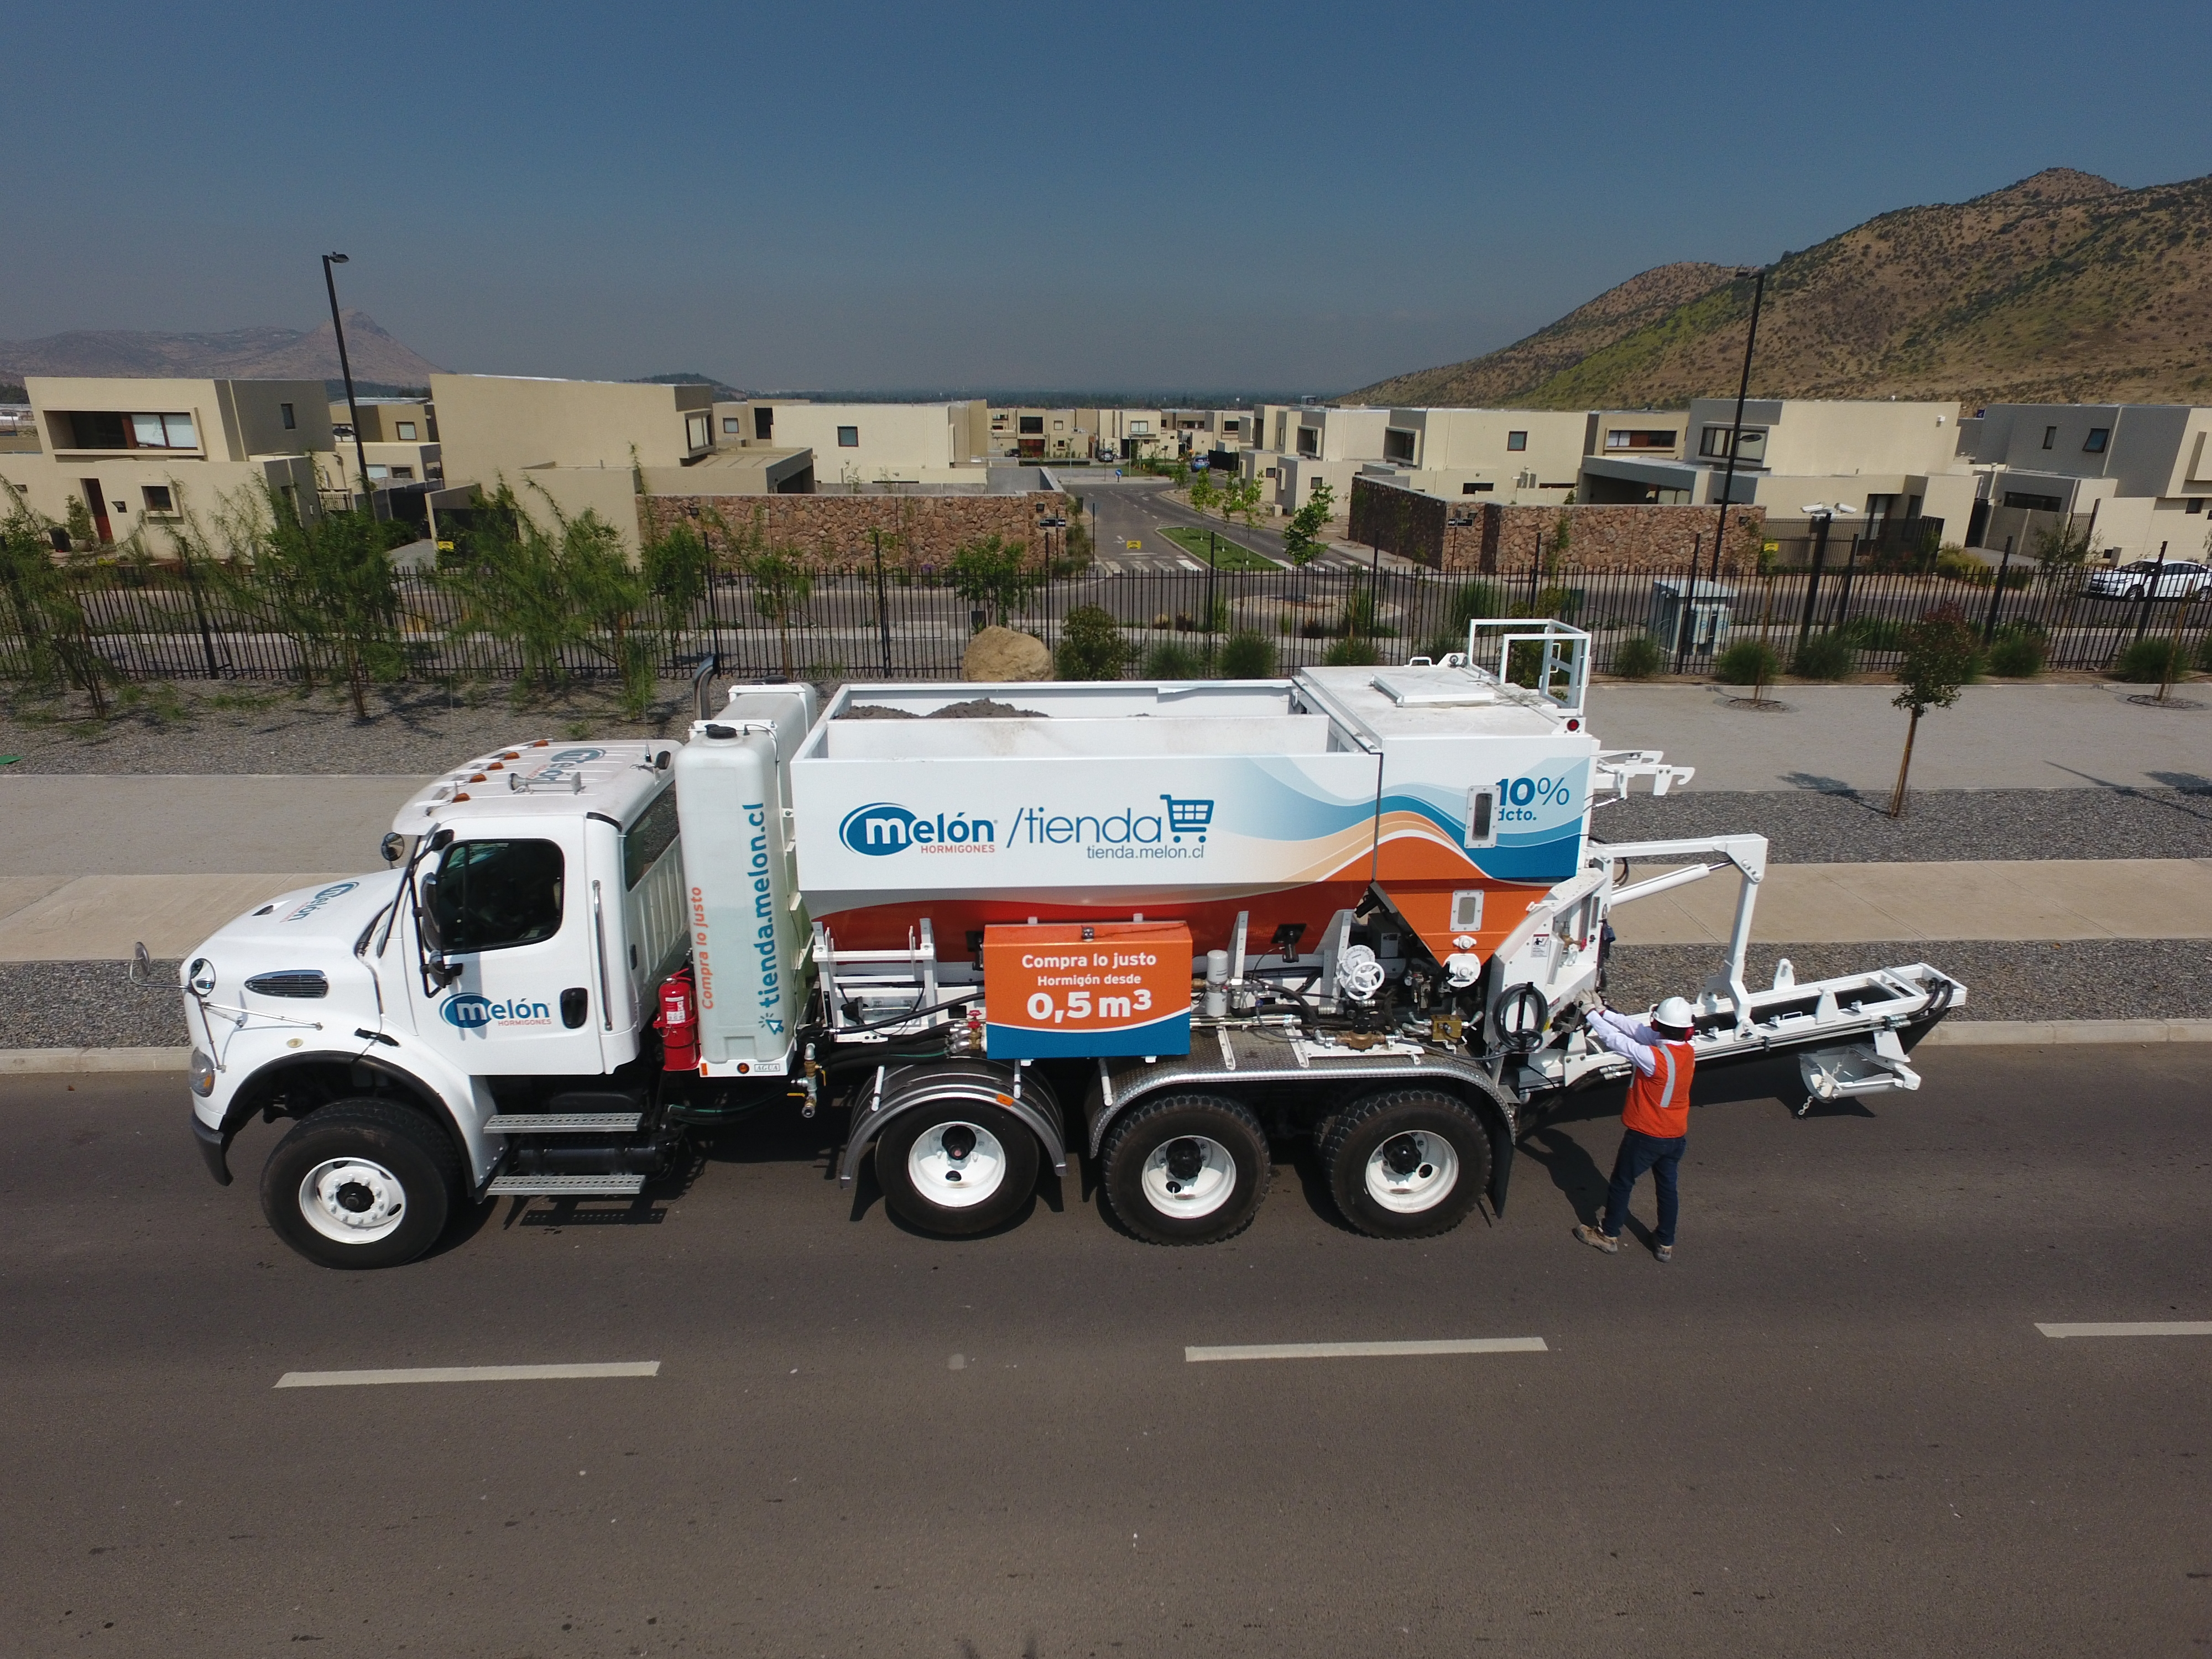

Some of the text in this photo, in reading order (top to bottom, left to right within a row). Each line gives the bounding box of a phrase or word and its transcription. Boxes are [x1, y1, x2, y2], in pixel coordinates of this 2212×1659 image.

[1495, 777, 1570, 806] 10%
[865, 812, 994, 845] melón
[921, 844, 995, 854] HORMIGONES
[1087, 845, 1204, 859] tienda.melon.cl
[742, 803, 780, 1008] tienda.melon.cl
[691, 886, 713, 1010] Compra lo justo
[1022, 952, 1157, 970] Compra lo justo
[1037, 974, 1141, 987] Hormigón desde
[456, 998, 550, 1021] melón
[1027, 992, 1092, 1023] 0,5
